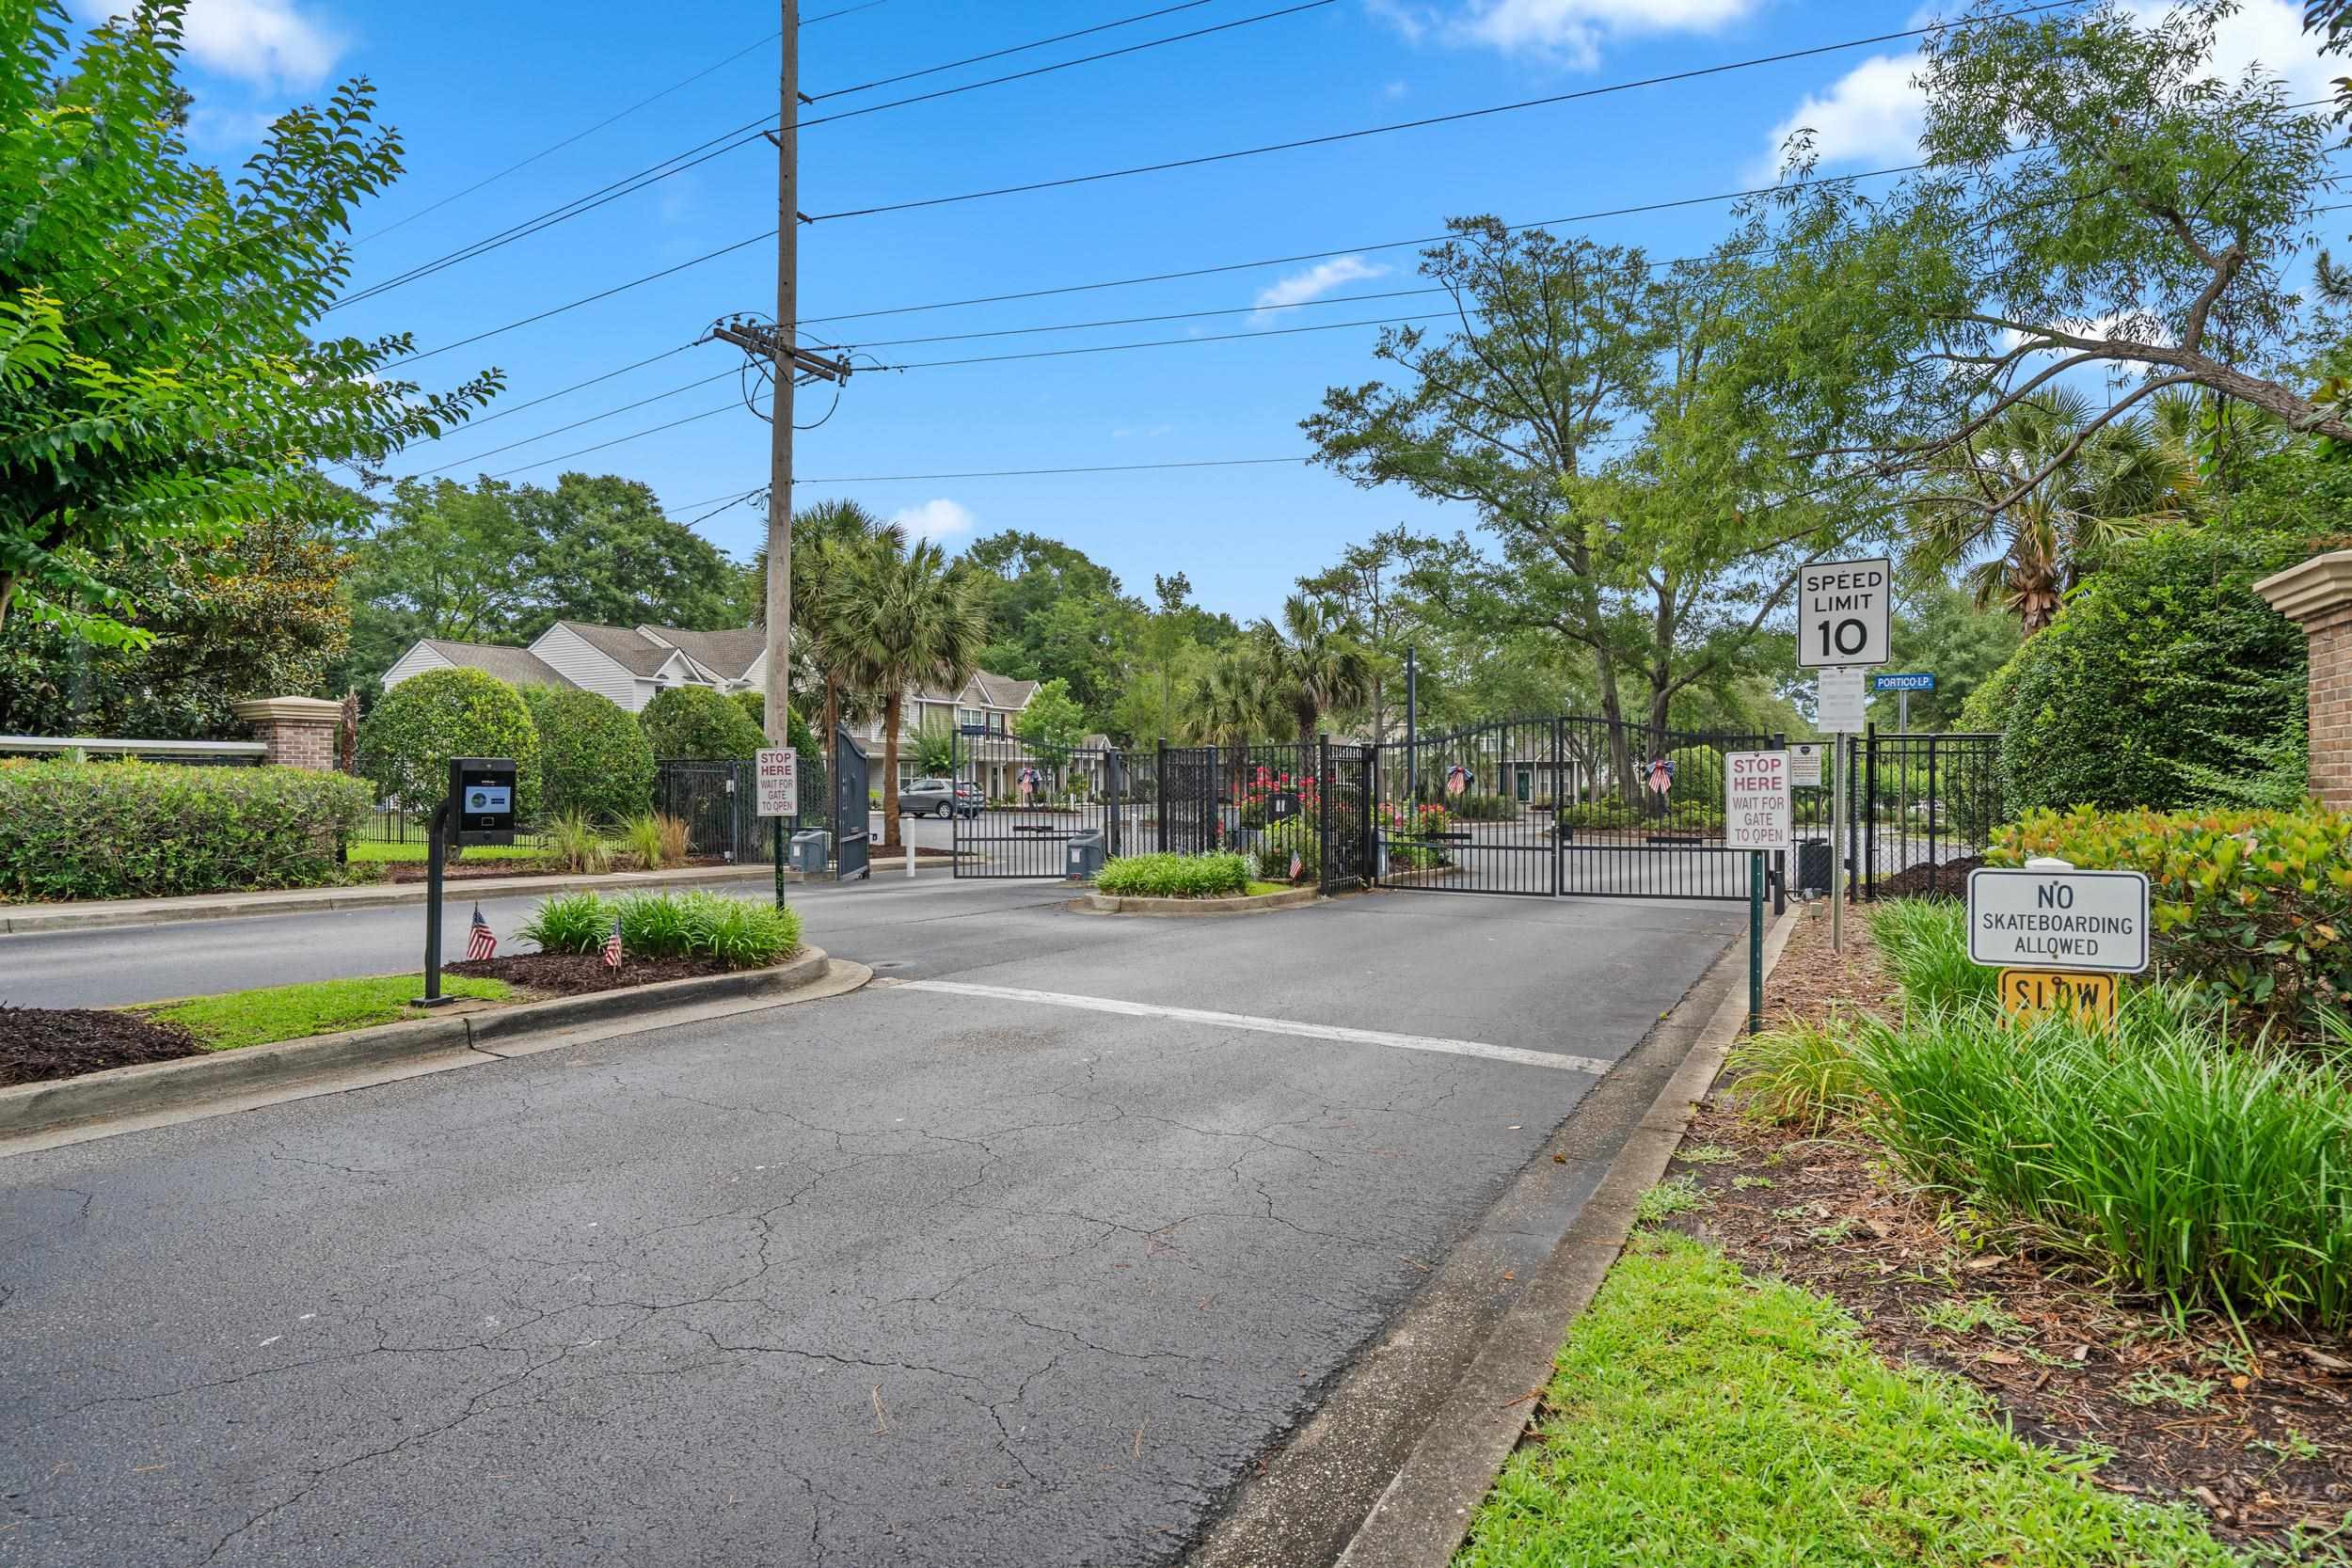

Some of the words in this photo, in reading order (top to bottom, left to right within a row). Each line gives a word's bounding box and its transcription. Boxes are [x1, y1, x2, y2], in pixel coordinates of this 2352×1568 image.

[1806, 571, 1883, 592] SPEED
[1815, 594, 1872, 612] LIMIT
[1818, 618, 1867, 657] 10
[1878, 677, 1915, 688] PORTICO
[761, 753, 791, 763] STOP
[761, 766, 791, 776] HERE
[1733, 758, 1782, 773] STOP
[760, 779, 777, 789] WAIT
[779, 779, 793, 789] FOR
[1733, 776, 1783, 791] HERE
[768, 790, 787, 800] GATE
[761, 801, 771, 811] TO
[773, 801, 792, 811] OPEN
[1732, 797, 1758, 810] WAIT
[1761, 797, 1785, 810] FOR
[1744, 813, 1773, 826] GATE
[1734, 829, 1749, 842] TO
[1753, 829, 1783, 842] OPEN
[2038, 884, 2074, 910] NO
[1982, 912, 2134, 935] SKATEBOARDING
[2013, 937, 2099, 956] ALLOWED
[2014, 979, 2100, 1012] SLOW
